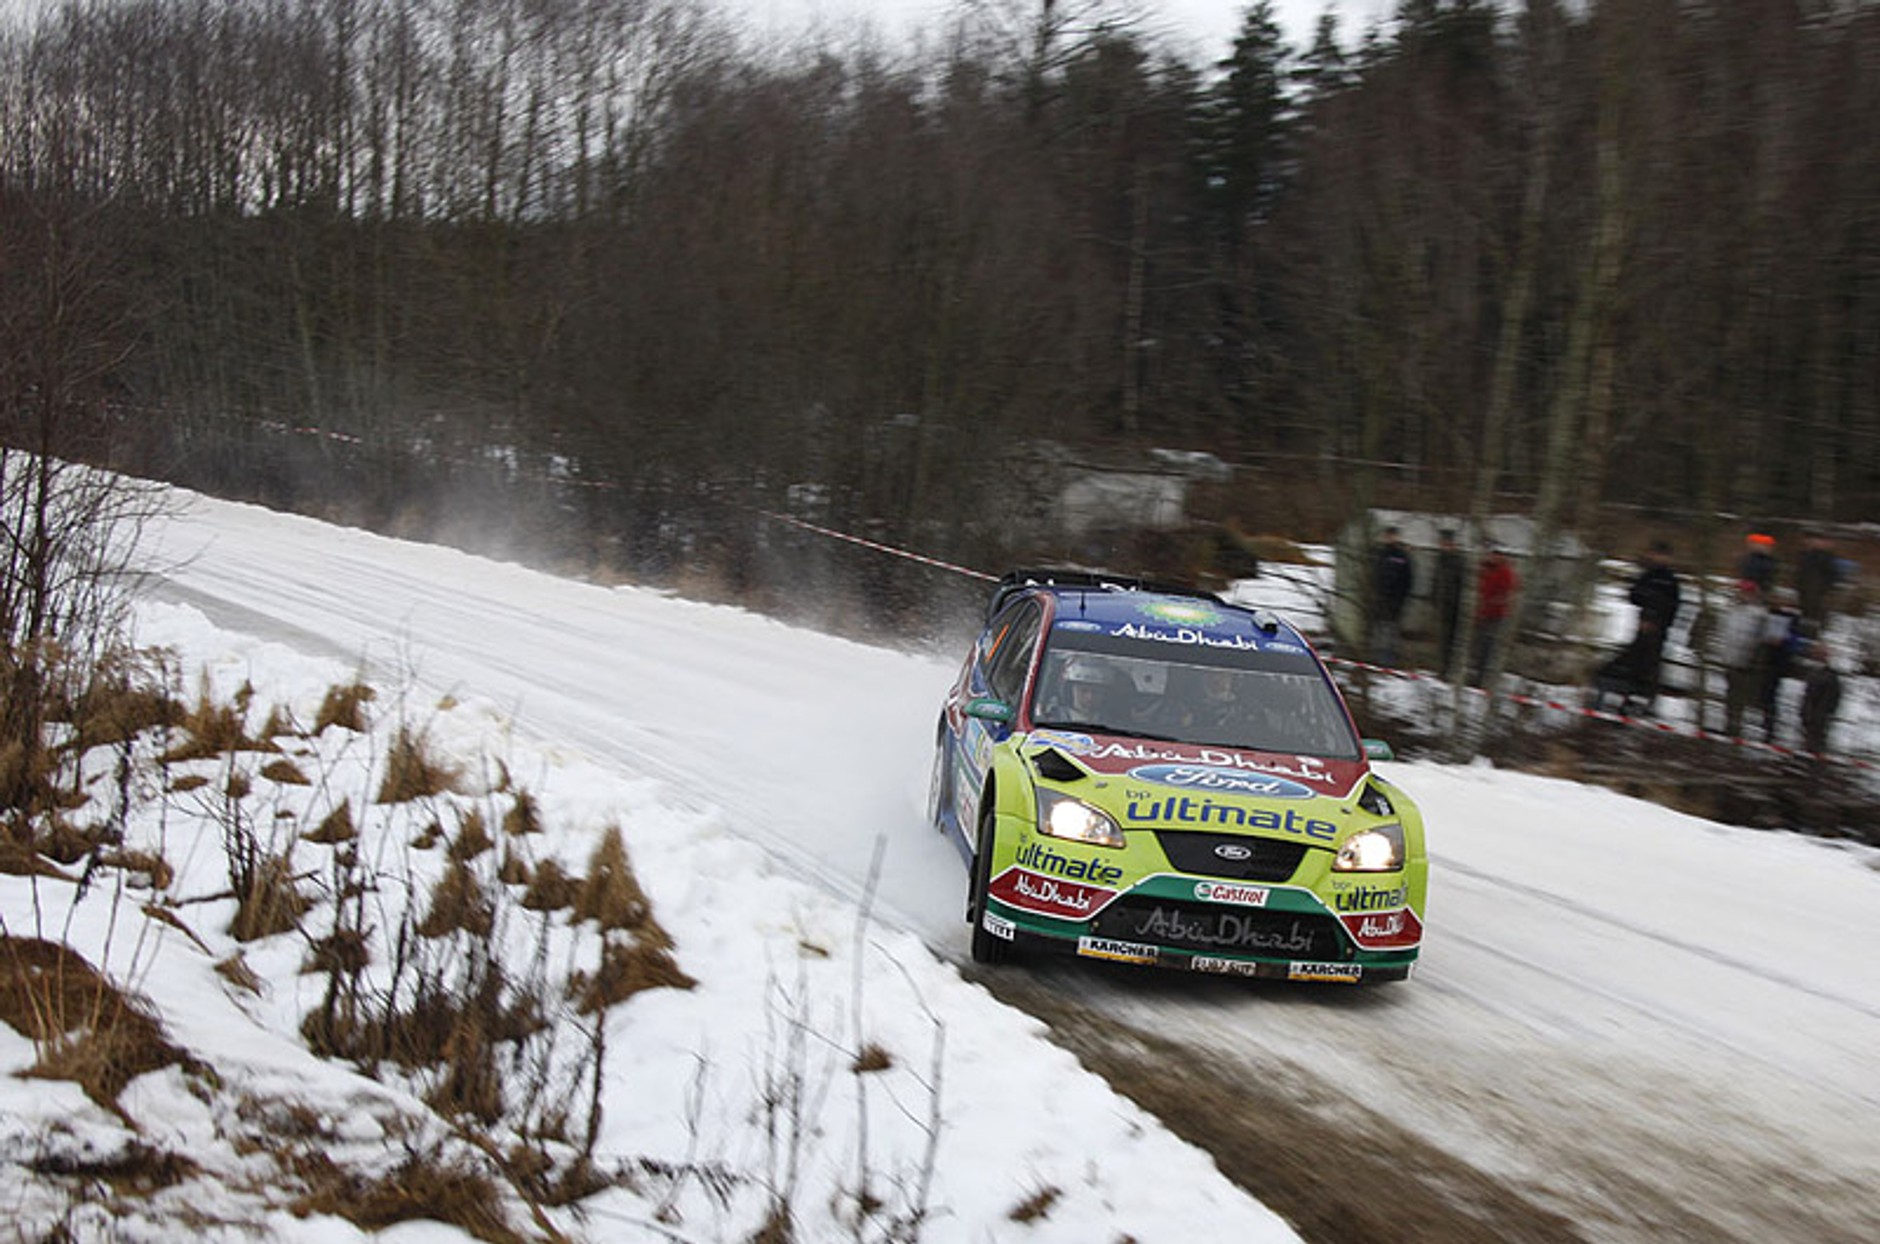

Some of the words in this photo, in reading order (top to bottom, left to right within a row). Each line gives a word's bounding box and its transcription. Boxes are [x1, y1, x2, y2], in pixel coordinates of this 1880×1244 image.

[1165, 767, 1281, 794] Ford
[1126, 797, 1337, 841] ultimate
[1015, 842, 1124, 885] ultimate
[1212, 885, 1266, 904] Castrol
